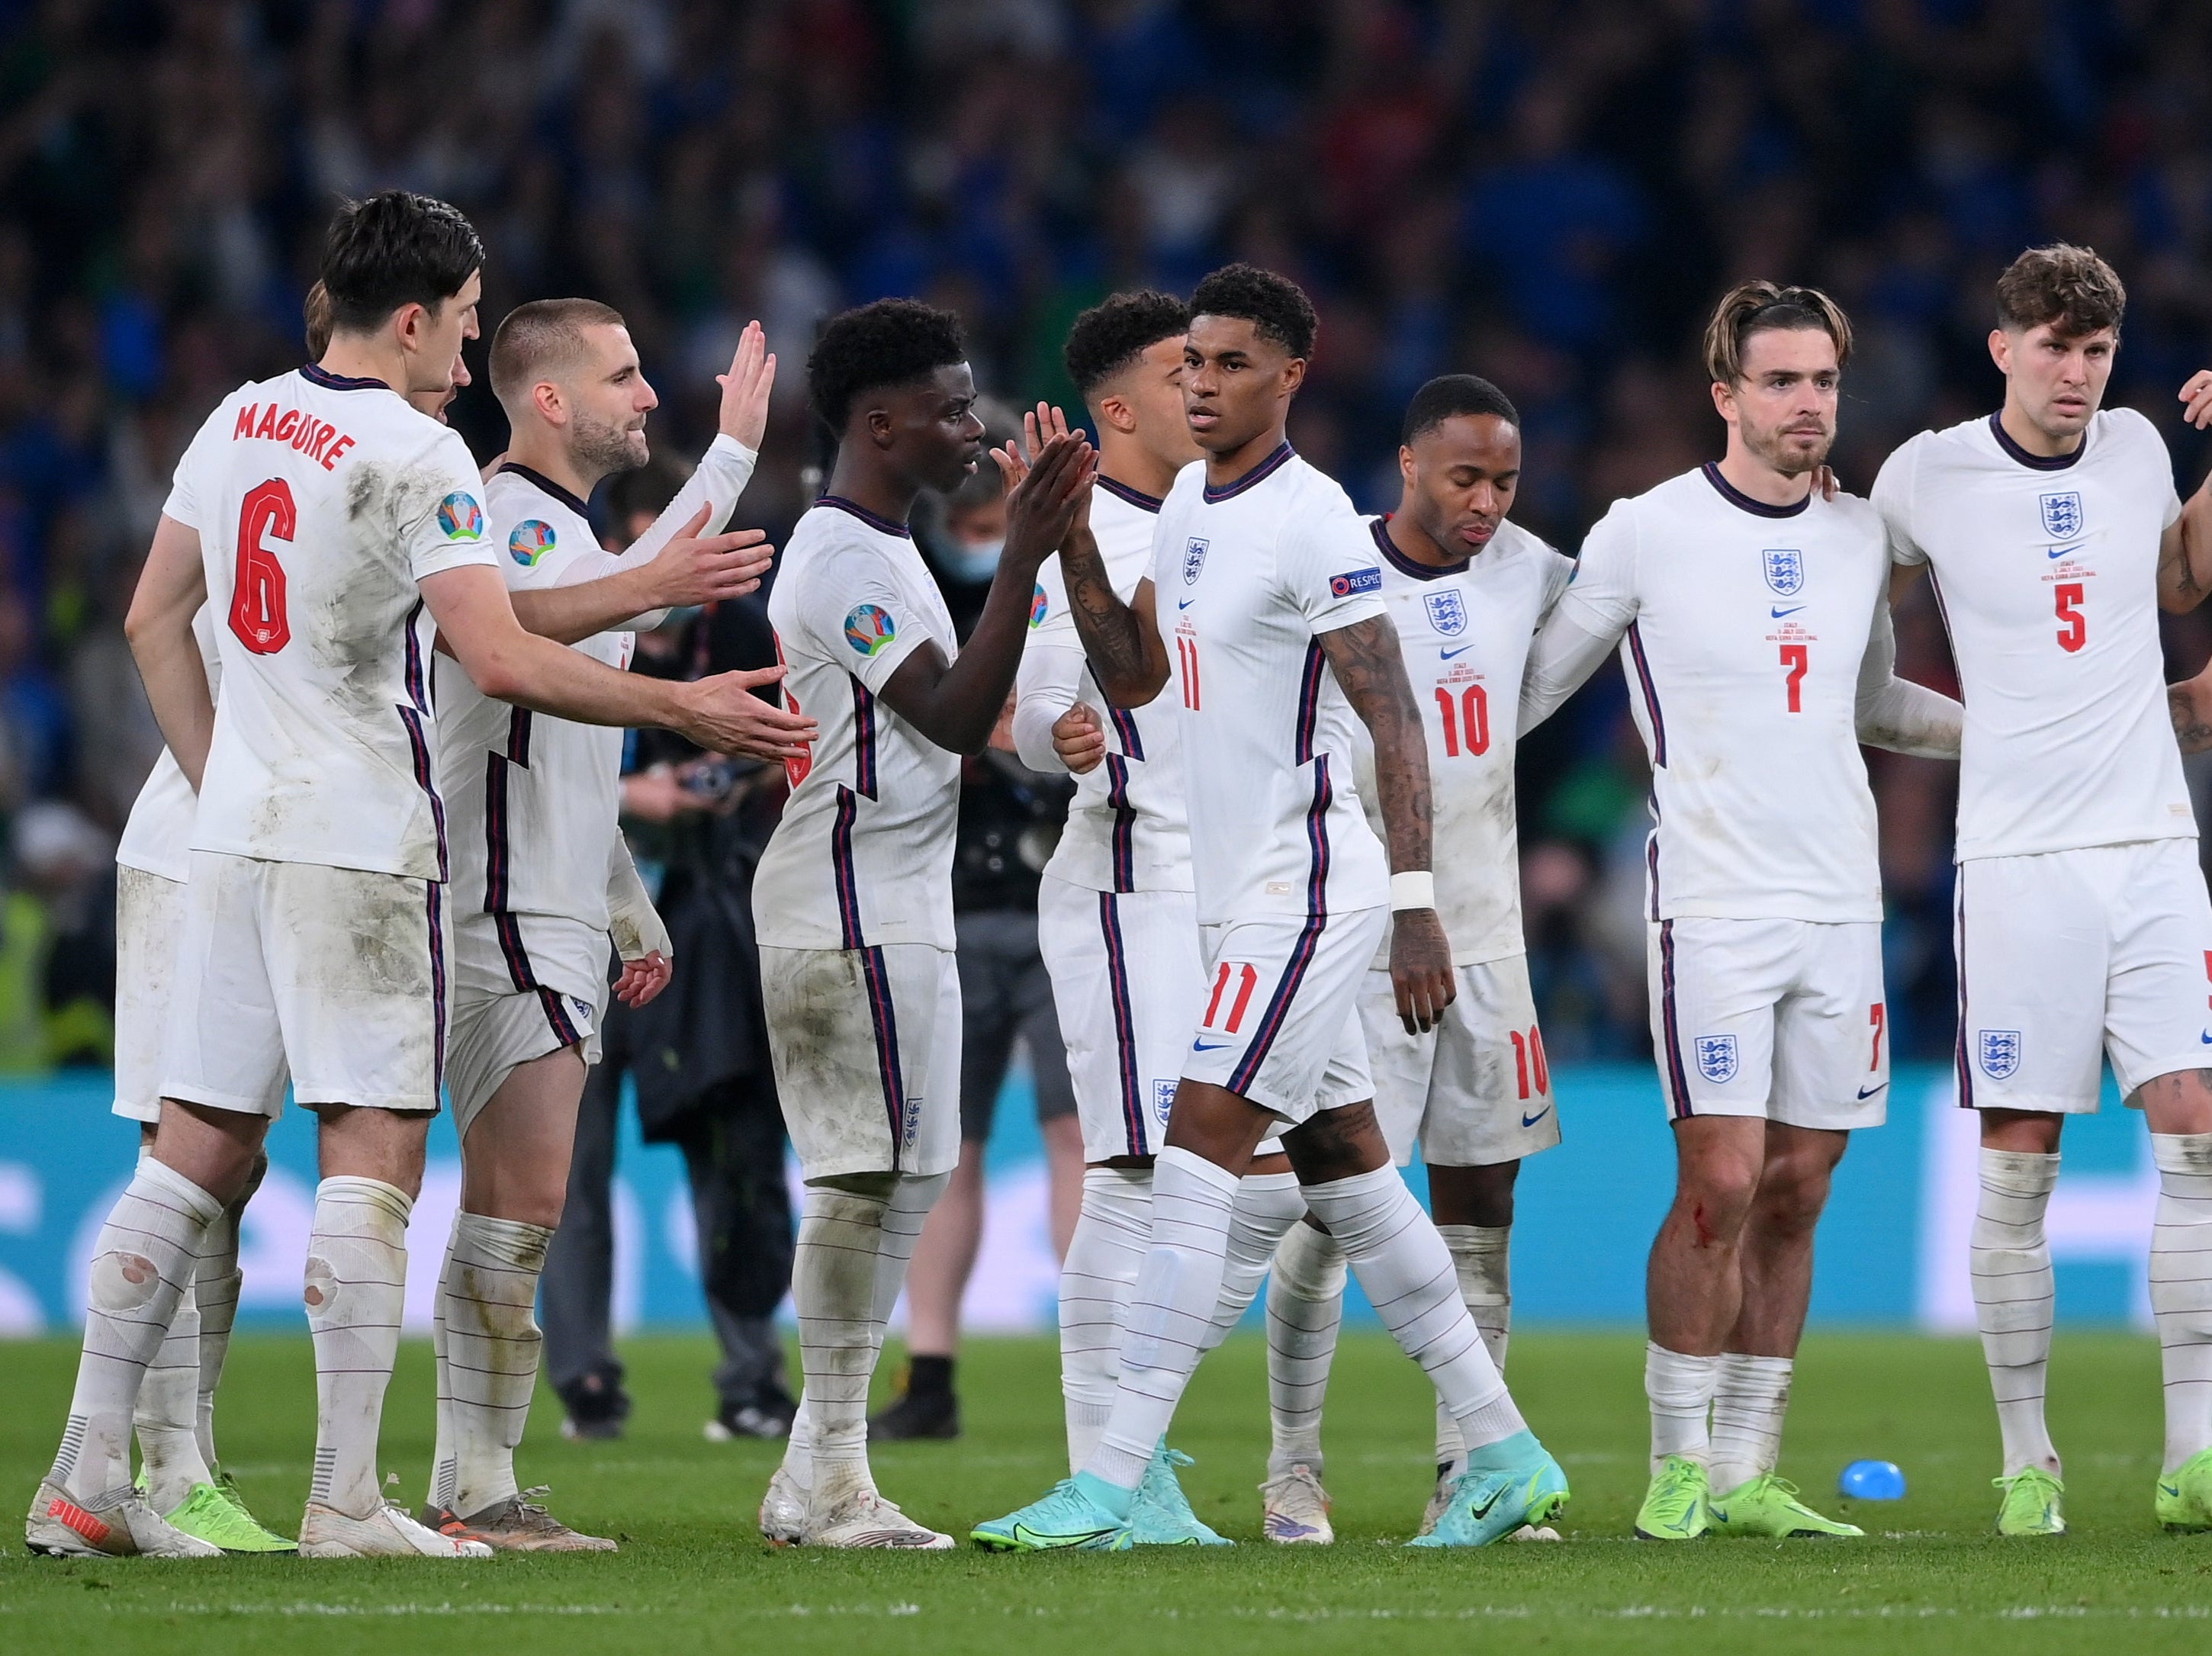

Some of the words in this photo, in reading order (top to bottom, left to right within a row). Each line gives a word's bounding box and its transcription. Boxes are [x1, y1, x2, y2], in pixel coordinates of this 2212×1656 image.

[233, 402, 356, 471] MAGUIRE
[227, 477, 297, 656] 6
[2054, 583, 2085, 653] 5
[1177, 635, 1200, 711] 11
[1779, 644, 1808, 712] 7
[1435, 683, 1490, 757] 10
[1202, 961, 1258, 1034] 11
[1509, 1024, 1548, 1100] 10
[1870, 1002, 1883, 1072] 7
